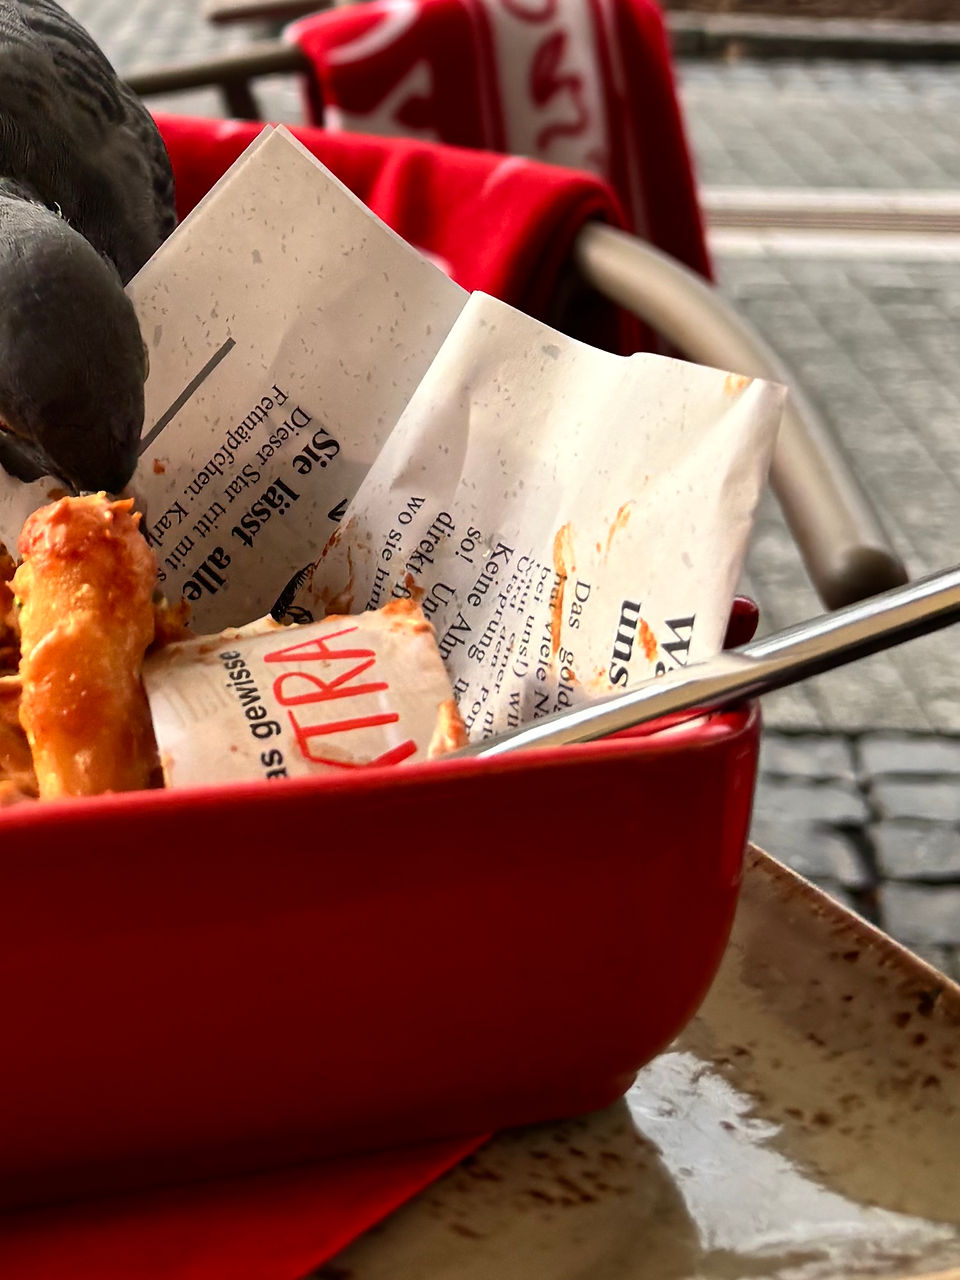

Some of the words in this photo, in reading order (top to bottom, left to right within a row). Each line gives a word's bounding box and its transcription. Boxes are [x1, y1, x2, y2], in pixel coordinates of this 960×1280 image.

[183, 384, 289, 500] Fettnäpfchen:
[255, 406, 313, 465] Dieser
[292, 428, 341, 475] Sie
[224, 462, 261, 504] Star
[398, 496, 425, 525] wo
[193, 499, 228, 538] tritt
[231, 477, 300, 548] lässt
[165, 535, 195, 570] mit
[382, 529, 402, 562] sie
[405, 511, 455, 575] direkt
[455, 526, 481, 564] so!
[183, 544, 232, 601] alle
[467, 542, 514, 607] Keine
[534, 567, 551, 603] bei
[468, 556, 529, 664] Ursprung
[569, 580, 591, 630] Das
[512, 614, 534, 678] uns!)
[609, 600, 641, 688] uns
[220, 650, 282, 739] gewisse
